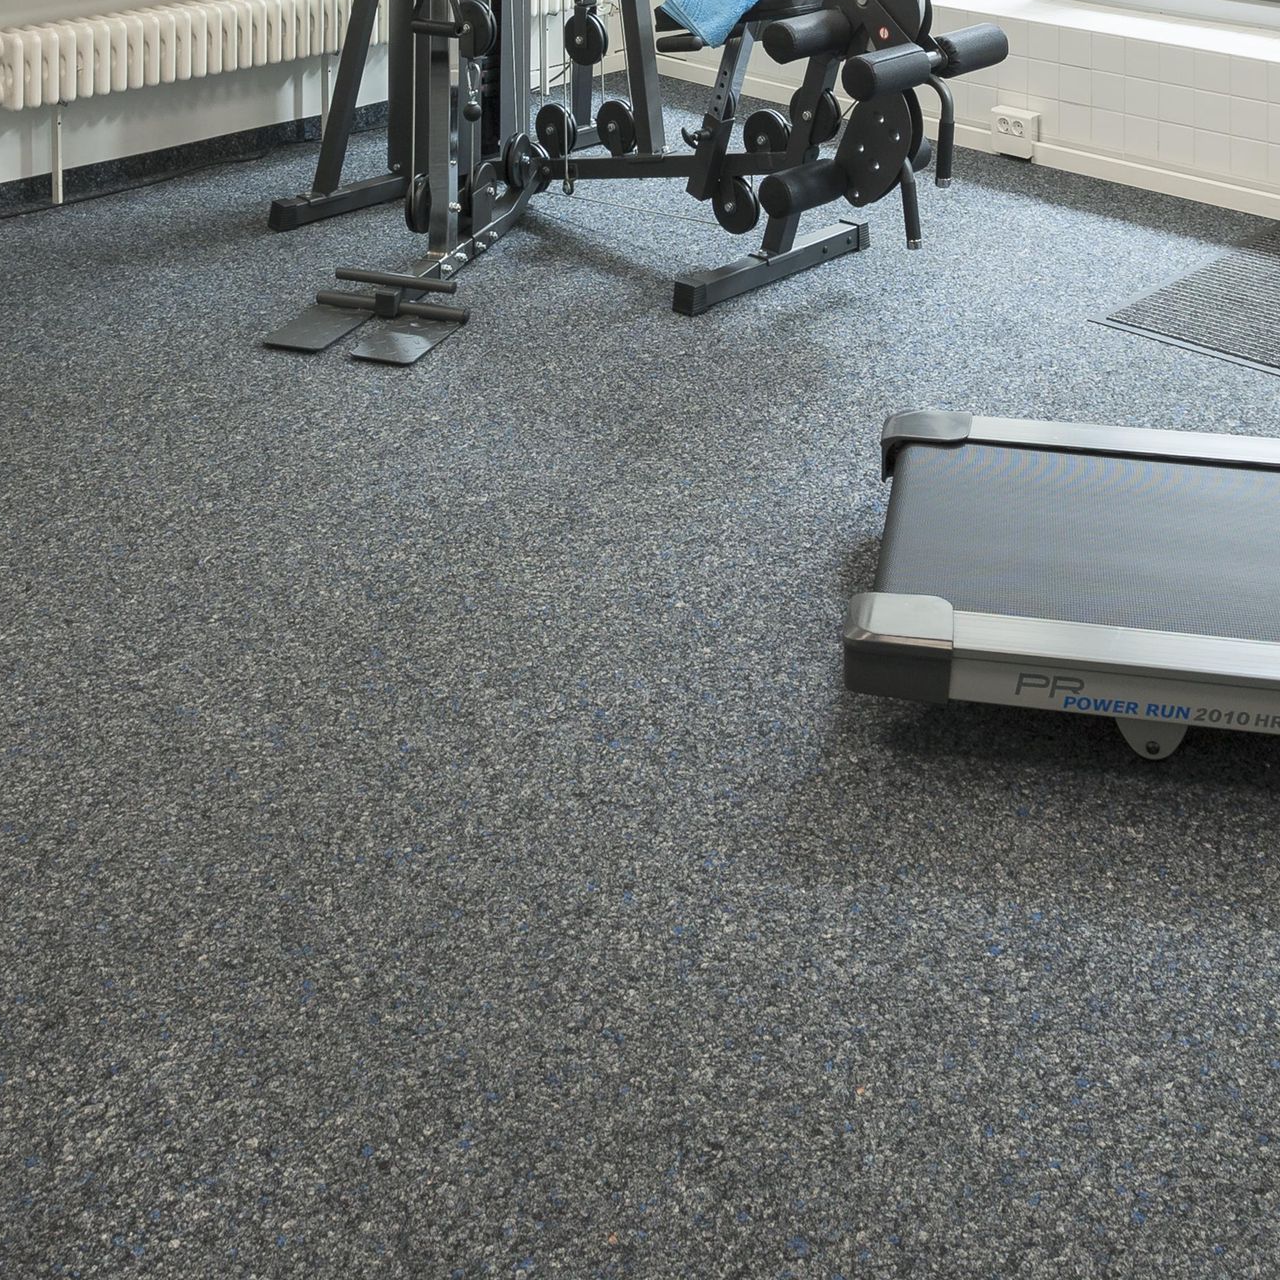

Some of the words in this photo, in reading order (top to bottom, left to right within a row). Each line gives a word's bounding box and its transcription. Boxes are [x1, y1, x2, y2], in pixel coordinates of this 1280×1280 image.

[1015, 672, 1085, 699] PR
[1063, 695, 1140, 716] POWER
[1145, 703, 1192, 720] RUN
[1194, 707, 1251, 726] 2010
